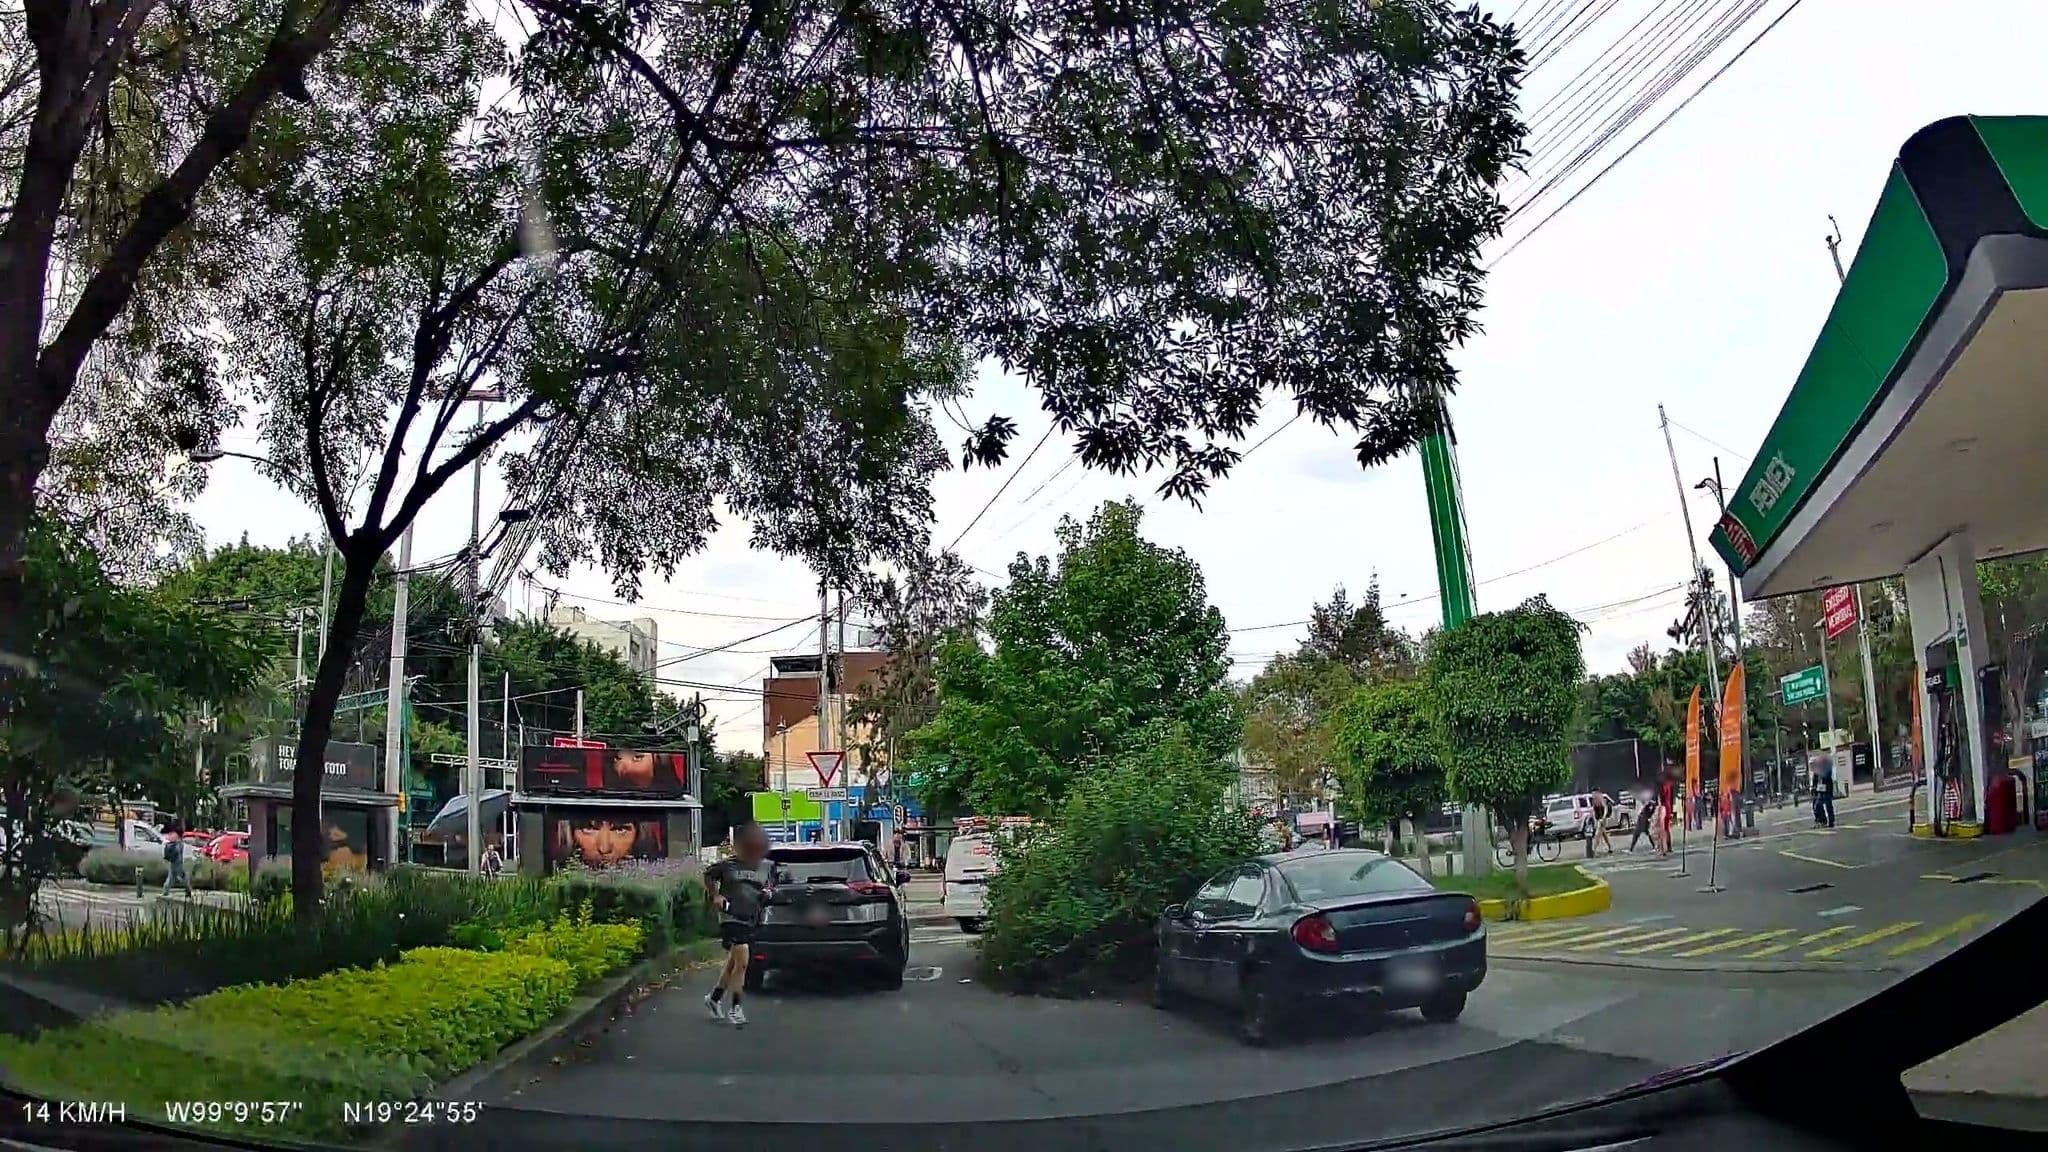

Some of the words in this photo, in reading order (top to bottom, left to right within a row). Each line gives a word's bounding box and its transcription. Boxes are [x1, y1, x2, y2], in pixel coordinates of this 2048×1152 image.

[1748, 448, 1796, 518] PEMEX
[278, 745, 296, 758] HEY
[279, 758, 297, 770] TOM
[324, 761, 347, 775] FOTO
